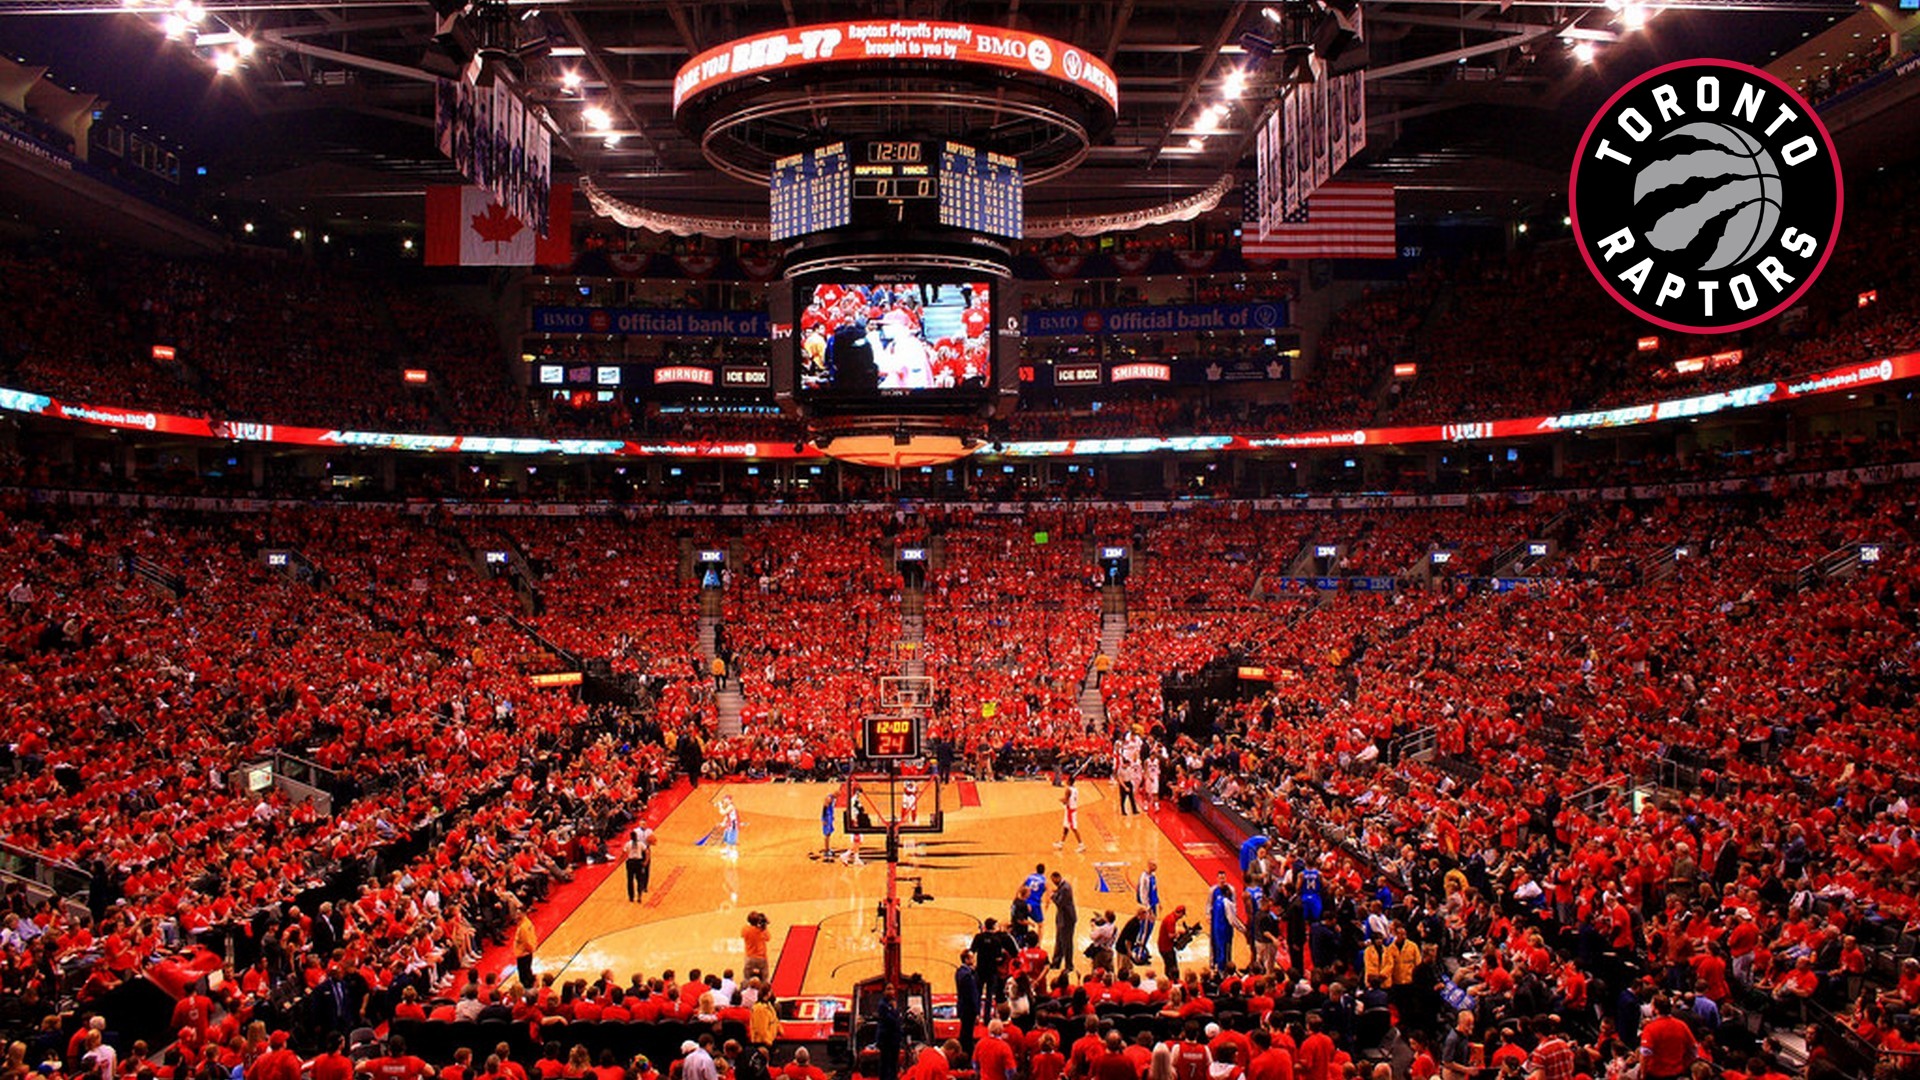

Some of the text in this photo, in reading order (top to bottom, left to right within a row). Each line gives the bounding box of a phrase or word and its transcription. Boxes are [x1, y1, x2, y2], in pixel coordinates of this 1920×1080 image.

[849, 22, 972, 44] Raptors Playoffs proudly
[865, 39, 957, 60] brought to you by
[976, 35, 1026, 58] BMO
[702, 53, 730, 80] YOU
[876, 143, 920, 160] 12:00
[855, 166, 893, 175] RAPTORS
[903, 166, 928, 175] MAGIC
[877, 179, 888, 197] 0
[918, 179, 930, 197] 0
[1403, 246, 1422, 257] 317
[543, 313, 584, 327] BMO
[618, 313, 758, 333] Official bank of
[1039, 316, 1078, 329] BMO
[1110, 308, 1249, 330] Official bank of
[657, 368, 711, 382] SMIRNOFF
[727, 371, 766, 382] ICE BOX
[1058, 369, 1098, 381] ICE BOX
[1113, 366, 1168, 381] SMIRNOFF
[877, 721, 910, 733] 12:00
[879, 736, 905, 754] 24
[1189, 1062, 1197, 1078] 7
